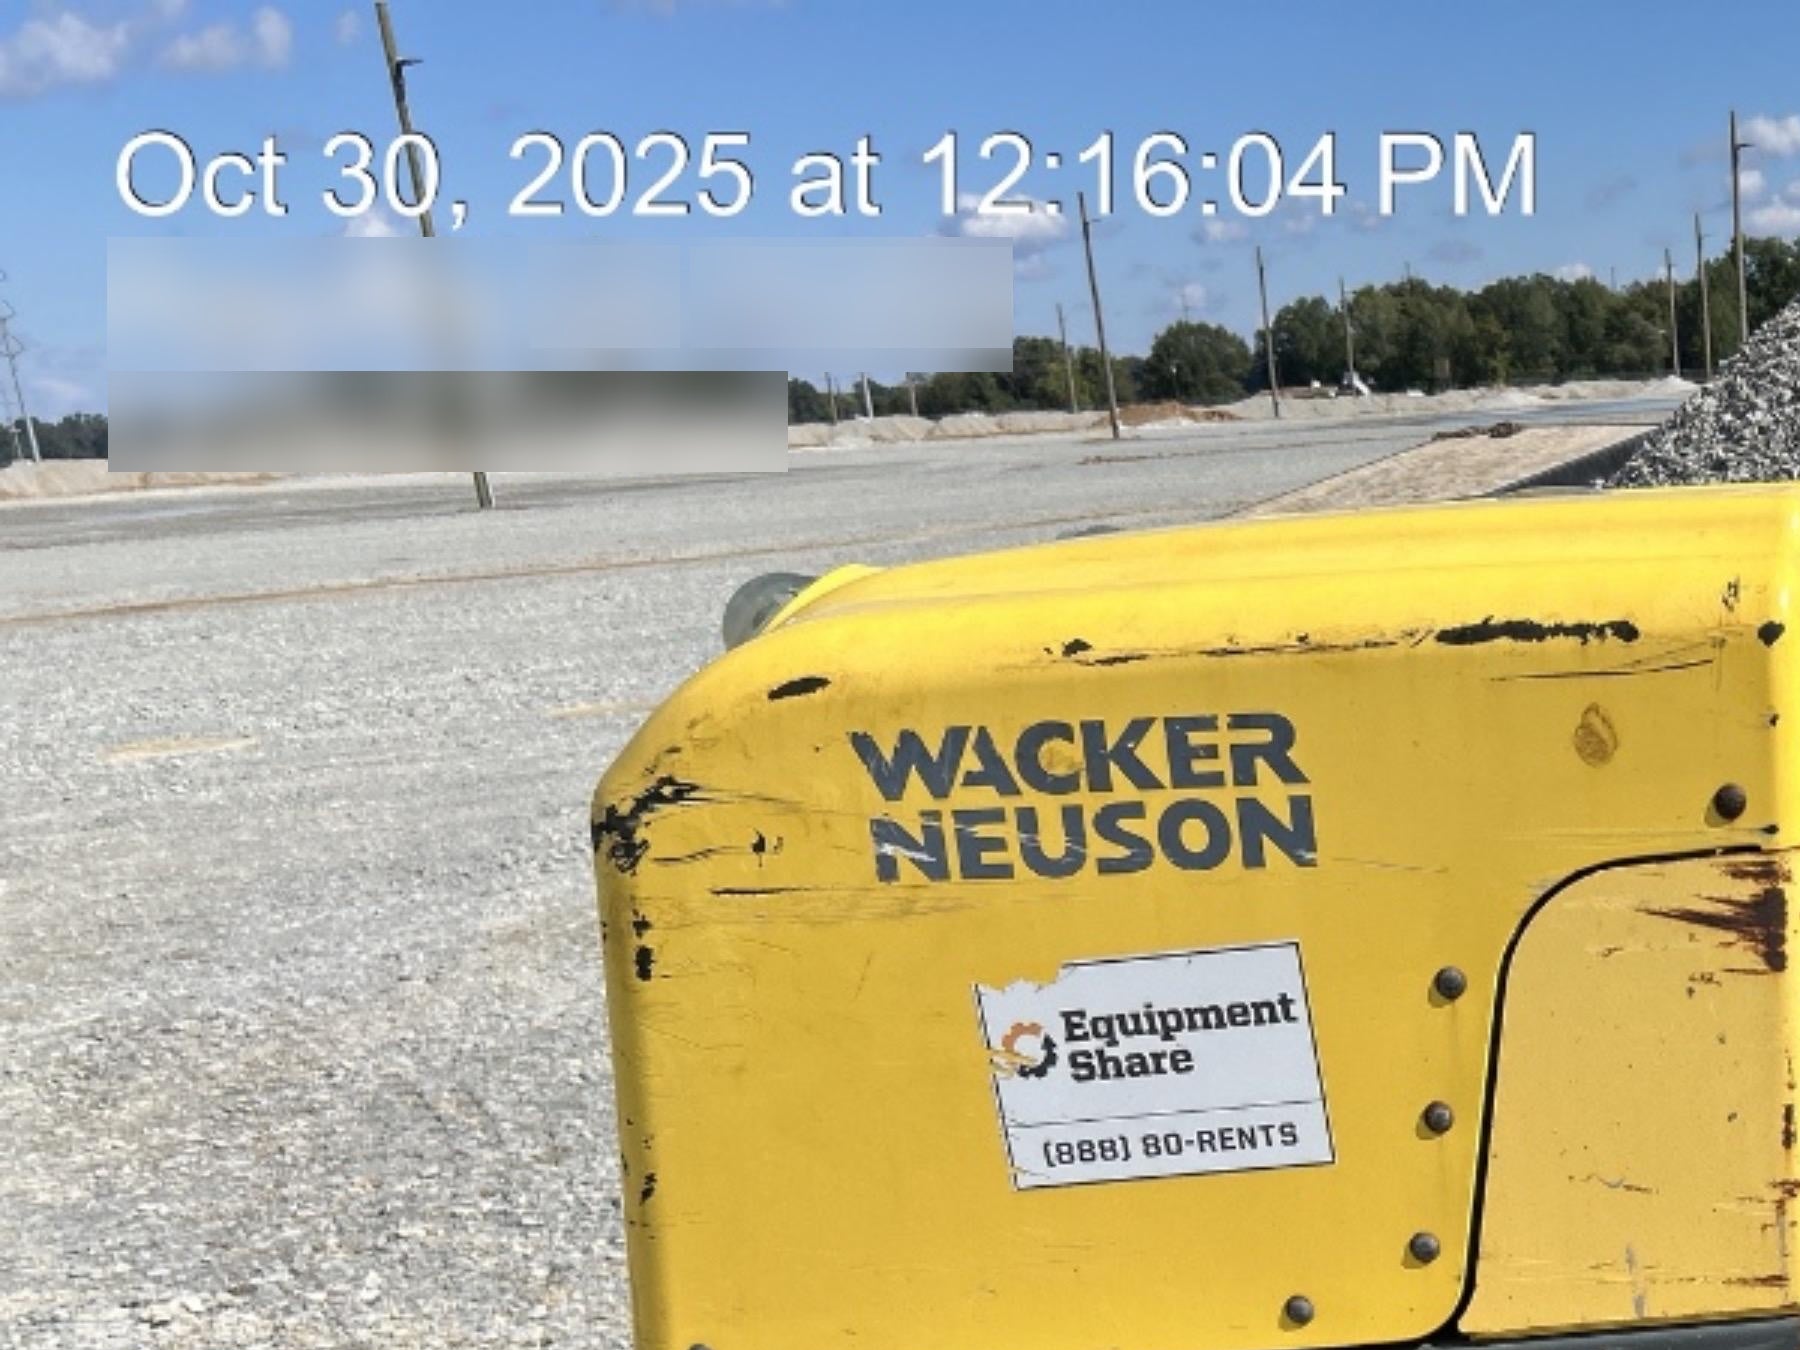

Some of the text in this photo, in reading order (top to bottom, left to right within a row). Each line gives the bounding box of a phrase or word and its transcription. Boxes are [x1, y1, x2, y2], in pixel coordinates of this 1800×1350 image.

[848, 712, 1311, 801] WACKER
[869, 794, 1318, 884] NEUSON
[1060, 992, 1298, 1049] Equipment
[1068, 1044, 1195, 1083] Share
[1043, 1121, 1299, 1168] (888) 80-RENTS
